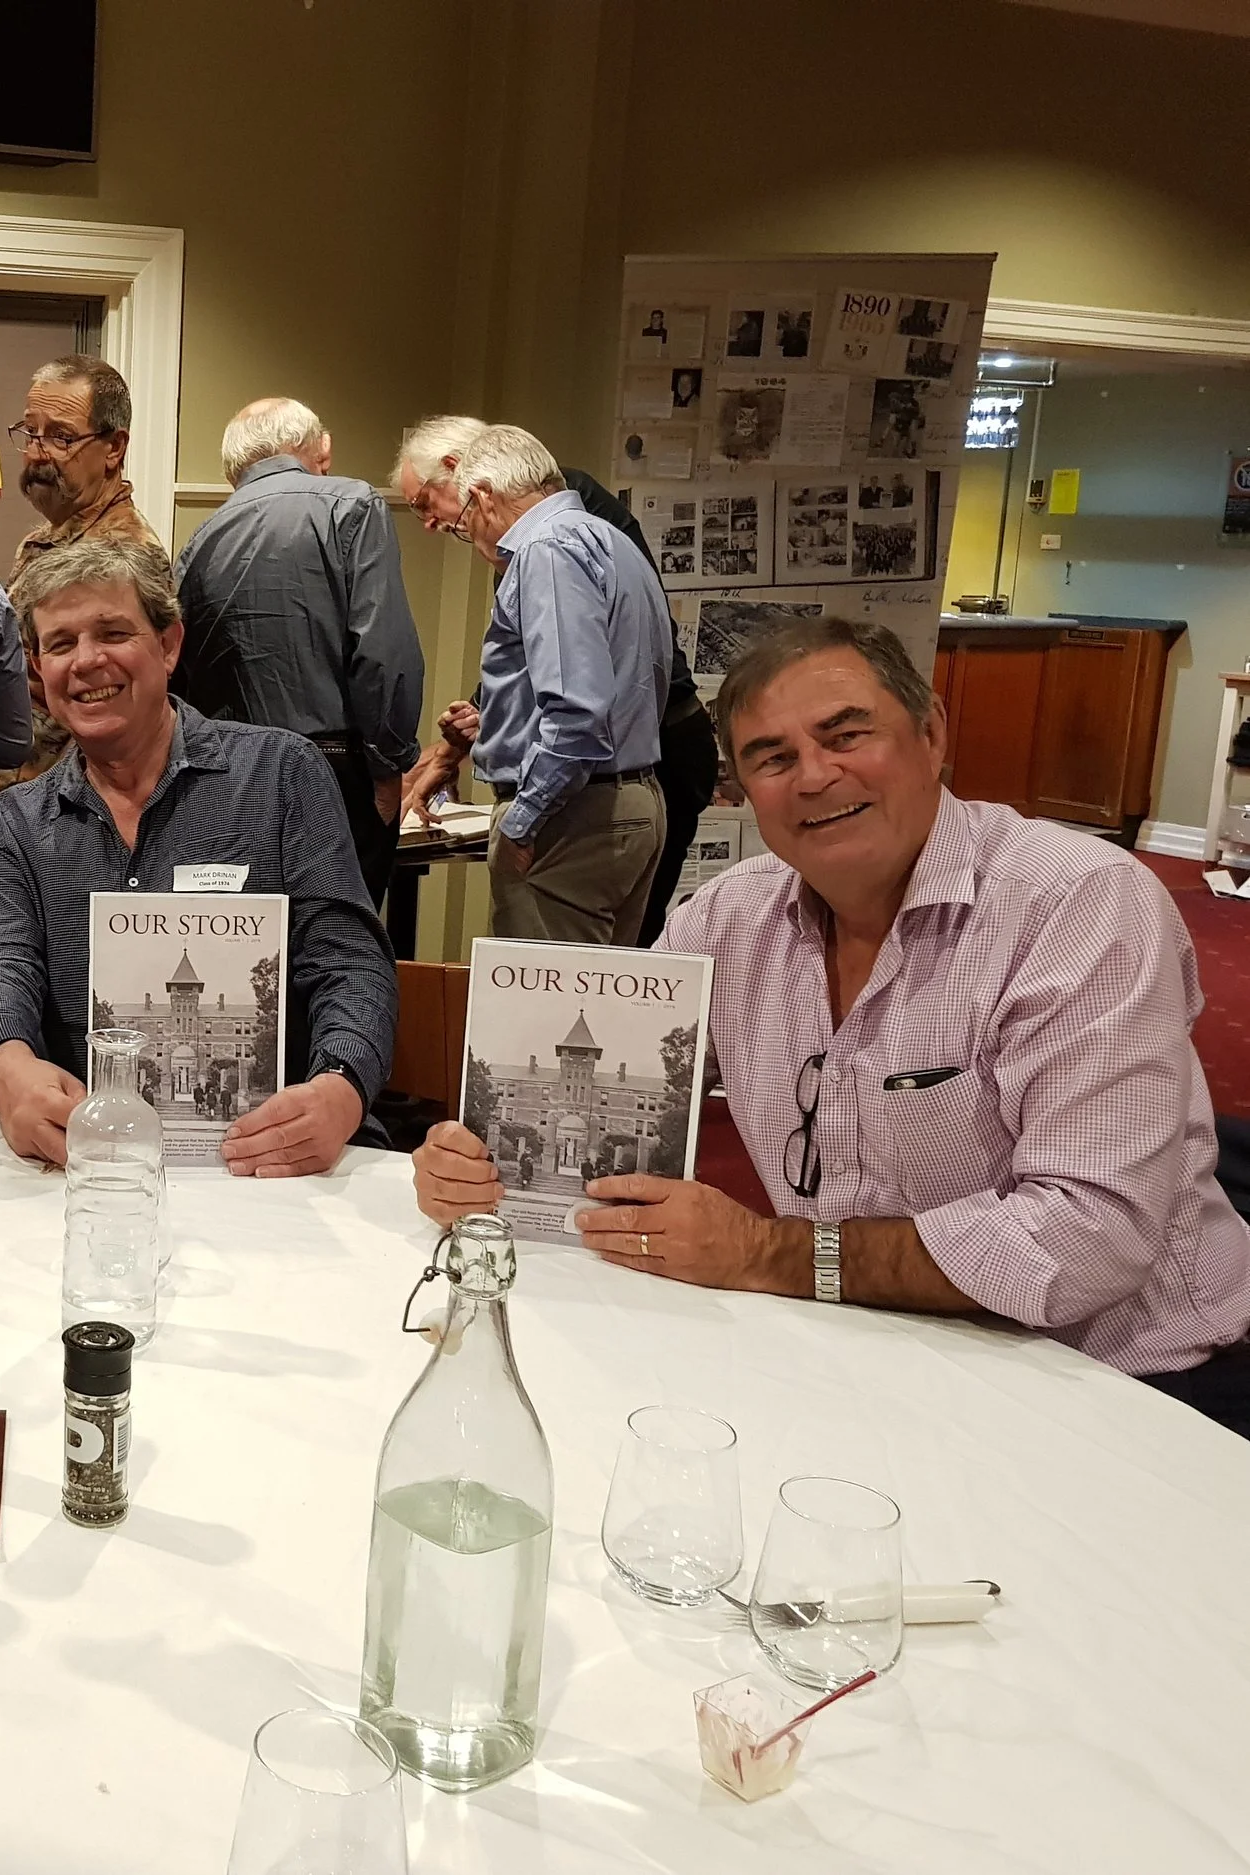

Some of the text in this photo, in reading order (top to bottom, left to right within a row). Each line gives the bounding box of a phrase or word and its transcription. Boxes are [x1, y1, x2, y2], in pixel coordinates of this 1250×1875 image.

[841, 293, 891, 317] 1890
[108, 913, 266, 936] OUR STORY
[491, 965, 684, 1001] OUR STORY
